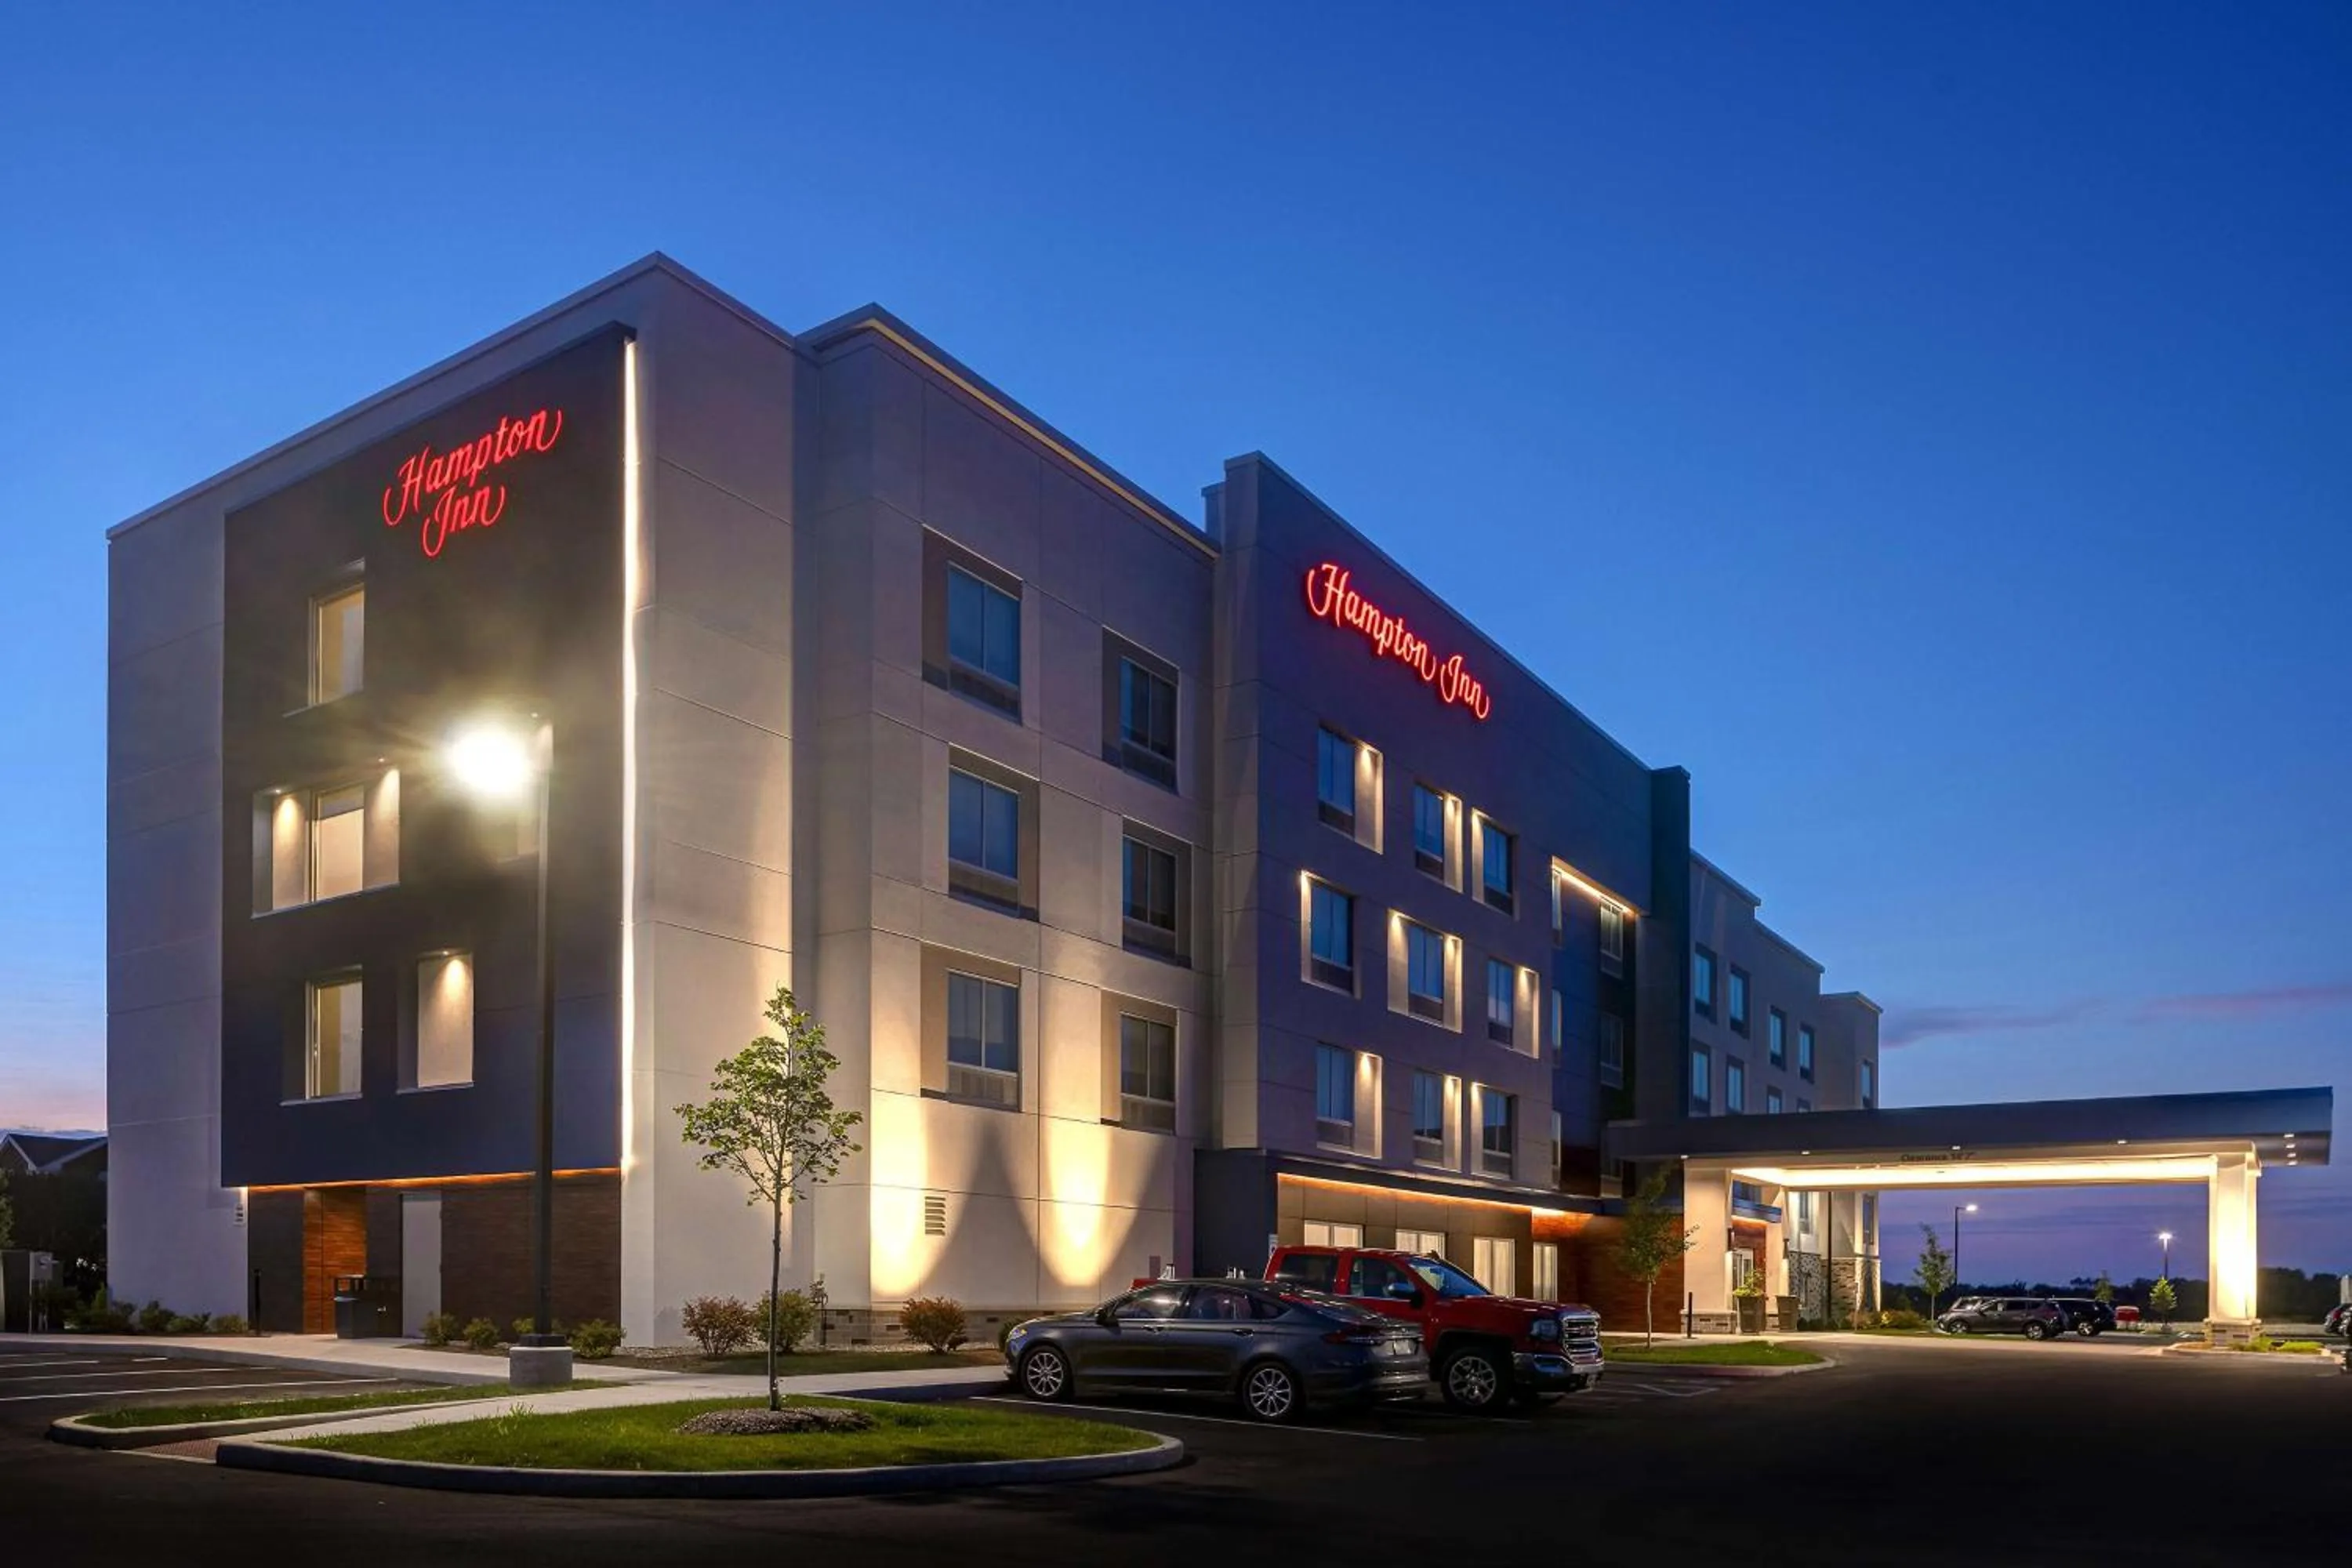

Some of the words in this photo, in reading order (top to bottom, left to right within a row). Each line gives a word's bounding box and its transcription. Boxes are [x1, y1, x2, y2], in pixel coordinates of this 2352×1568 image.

[383, 408, 562, 526] Hampton
[422, 485, 506, 557] Inn
[1307, 563, 1436, 681] Hampton
[1440, 655, 1490, 719] Inn
